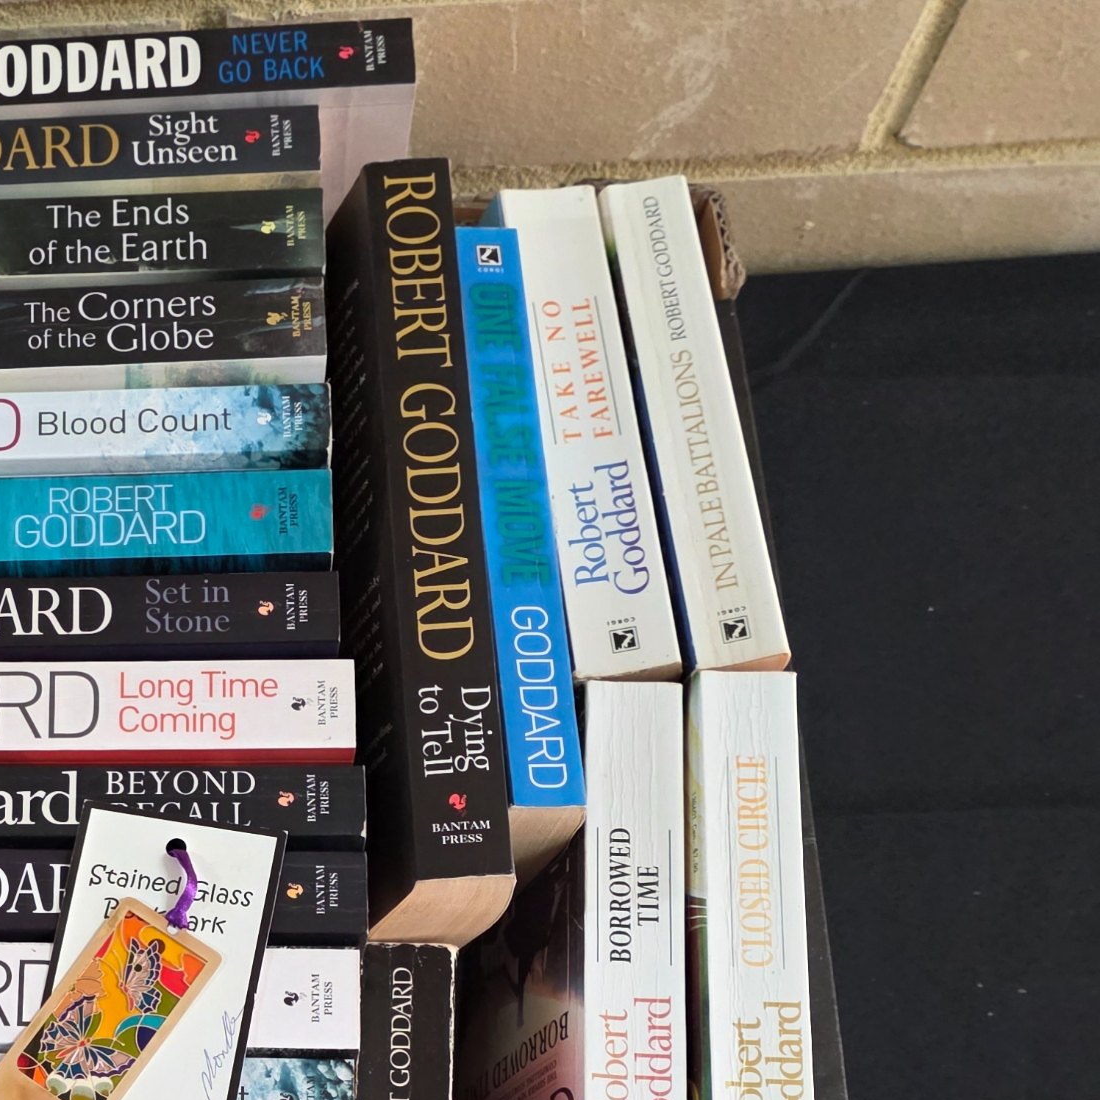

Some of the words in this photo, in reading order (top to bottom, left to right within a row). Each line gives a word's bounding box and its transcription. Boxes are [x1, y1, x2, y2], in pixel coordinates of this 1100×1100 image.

[233, 30, 308, 55] NEVER
[365, 30, 376, 72] BANTAM
[377, 34, 388, 64] PRESS
[219, 59, 251, 84] GO
[264, 56, 324, 81] BACK
[149, 111, 219, 145] Sight
[271, 113, 280, 157] BANTAM
[283, 119, 293, 149] PRESS
[132, 140, 238, 166] Unseen
[47, 205, 101, 229] The
[112, 197, 190, 227] Ends
[28, 239, 57, 266] of
[66, 239, 111, 264] the
[122, 231, 208, 263] Earth
[383, 172, 453, 368] ROBERT
[23, 302, 71, 324] The
[78, 291, 217, 322] Corners
[541, 300, 567, 341] NO
[28, 328, 52, 350] of
[58, 327, 97, 348] the
[107, 321, 214, 352] Globe
[571, 297, 613, 440] FAREWELL
[551, 362, 583, 443] TAKE
[38, 409, 126, 436] Blood
[138, 407, 233, 433] Count
[400, 383, 474, 660] GODDARD
[145, 578, 192, 604] Set
[203, 579, 230, 603] in
[286, 583, 296, 631] BANTAM
[298, 589, 309, 623] PRESS
[145, 607, 230, 634] Stone
[417, 684, 439, 714] to
[448, 685, 491, 772] Dying
[418, 721, 454, 779] Tell
[432, 819, 491, 833] BANTAM
[441, 832, 483, 845] PRESS
[89, 864, 182, 896] Stained
[609, 826, 632, 964] BORROWED
[637, 864, 660, 926] TIME
[390, 966, 414, 1088] GODDARD
